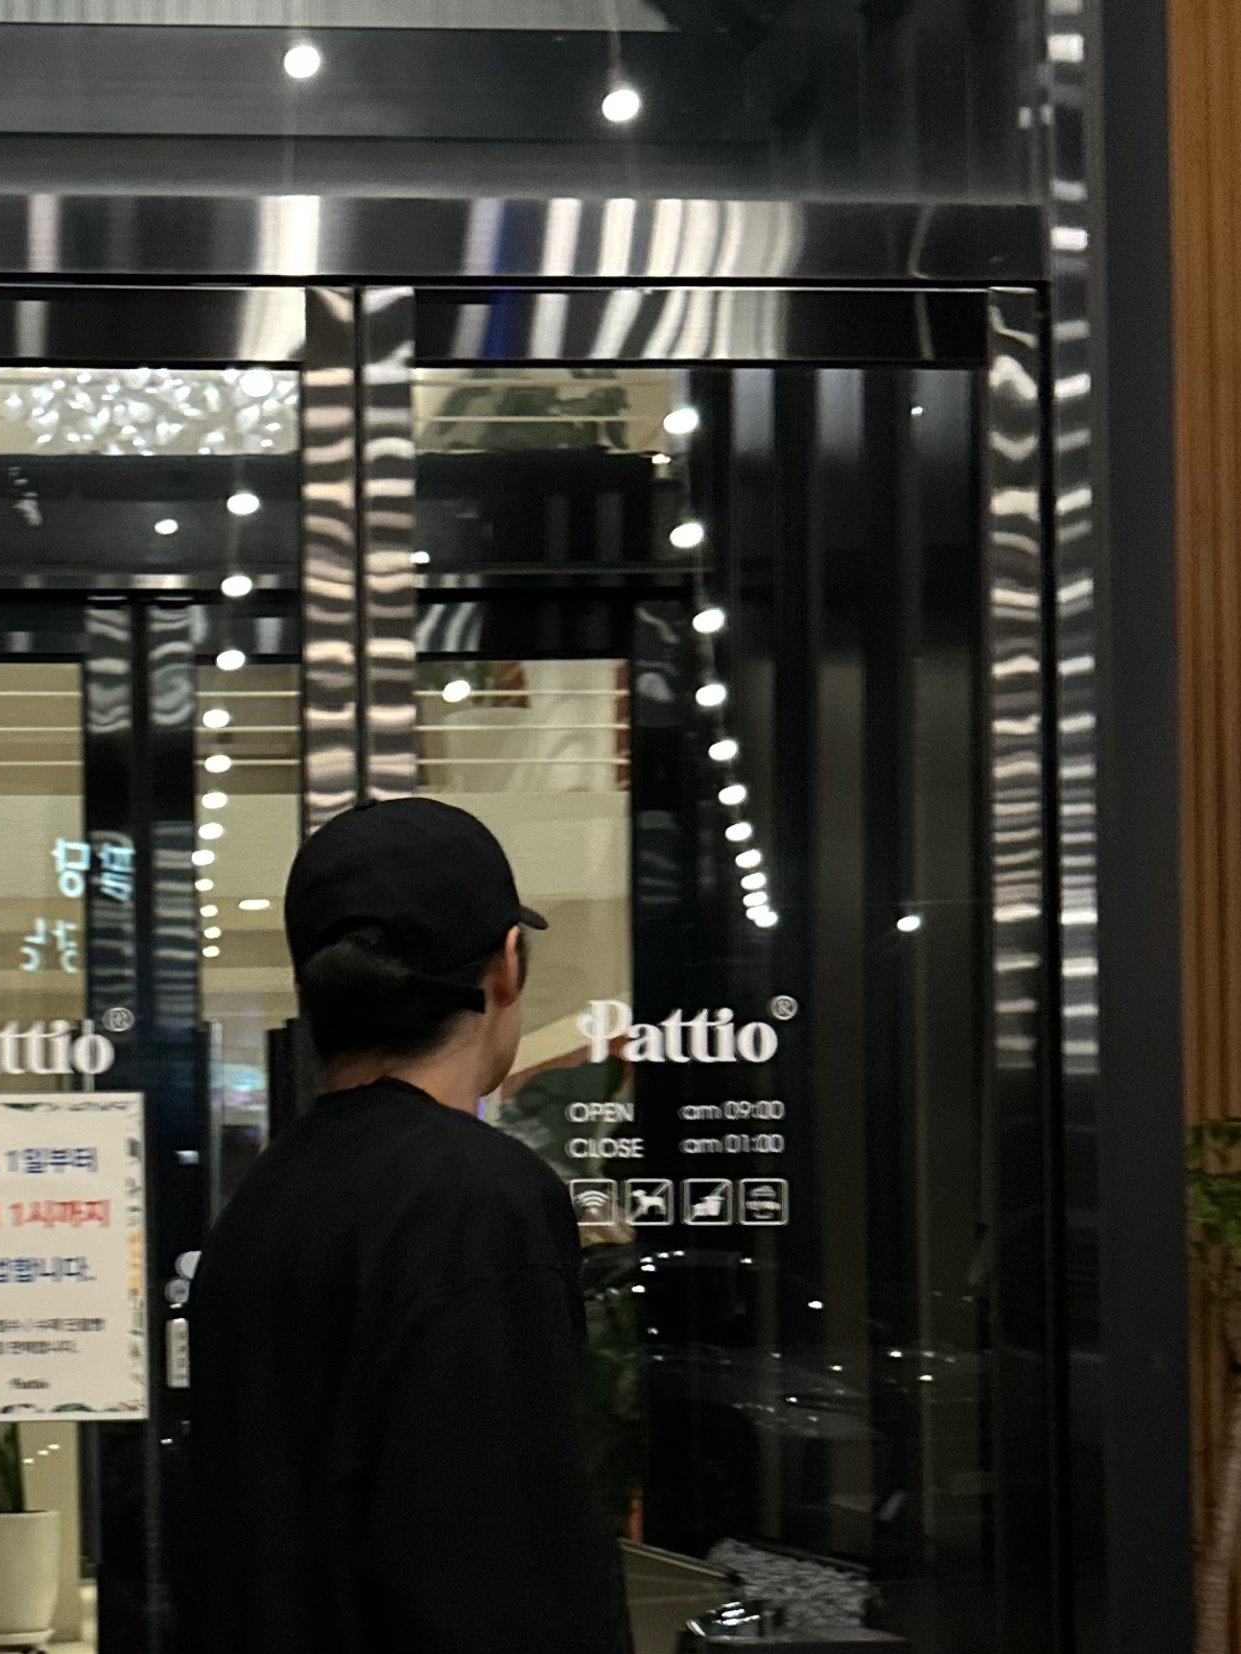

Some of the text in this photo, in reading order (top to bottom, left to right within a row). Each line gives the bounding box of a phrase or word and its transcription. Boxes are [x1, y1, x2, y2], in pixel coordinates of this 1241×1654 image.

[577, 999, 779, 1063] Pattio
[565, 1100, 785, 1122] OPEN am 09:00
[565, 1134, 785, 1158] CLOSE am 01:00
[5, 1147, 98, 1174] 1일부터
[8, 1199, 111, 1229] 1시까지
